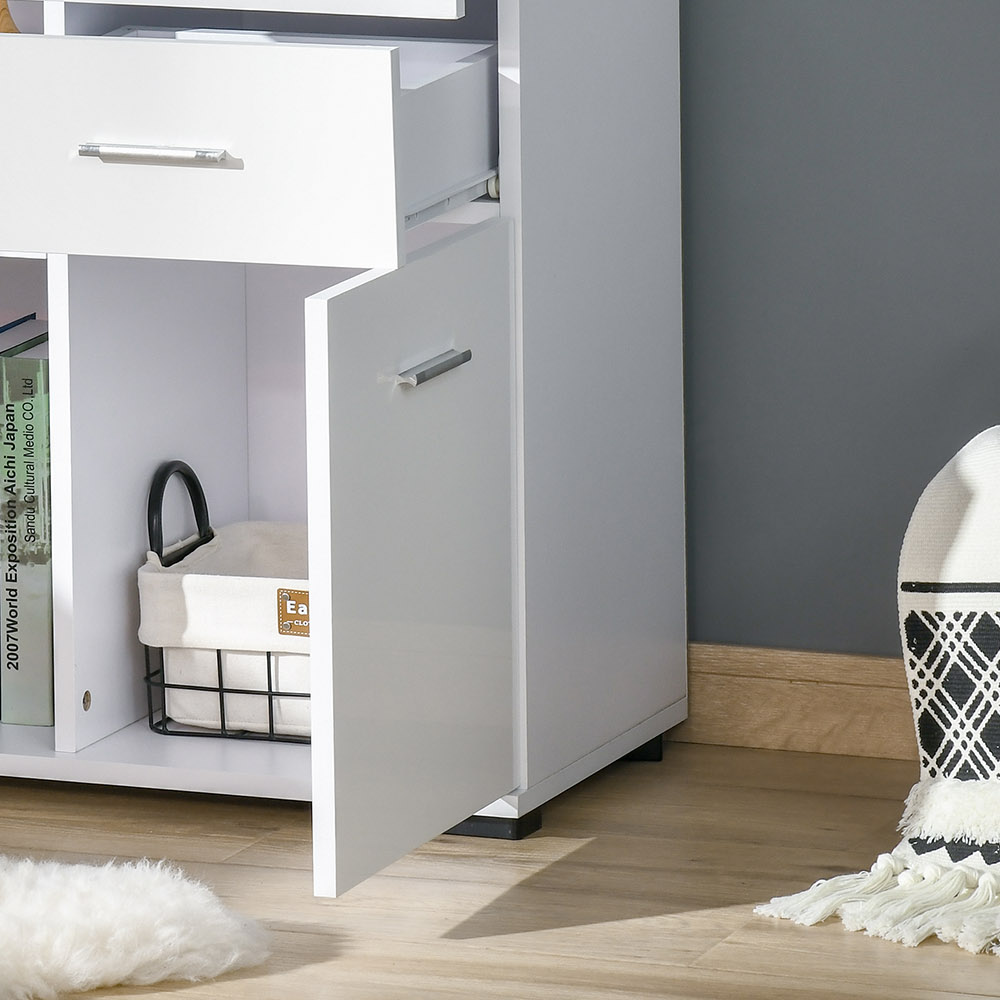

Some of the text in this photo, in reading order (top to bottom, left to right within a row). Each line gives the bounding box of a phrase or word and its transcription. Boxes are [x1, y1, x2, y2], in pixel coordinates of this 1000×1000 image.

[22, 424, 34, 458] Medio
[23, 460, 36, 504] Cultural
[3, 403, 20, 671] 2007World Exposition Aichi Japan
[24, 507, 37, 543] Sandu
[294, 619, 310, 627] CLO
